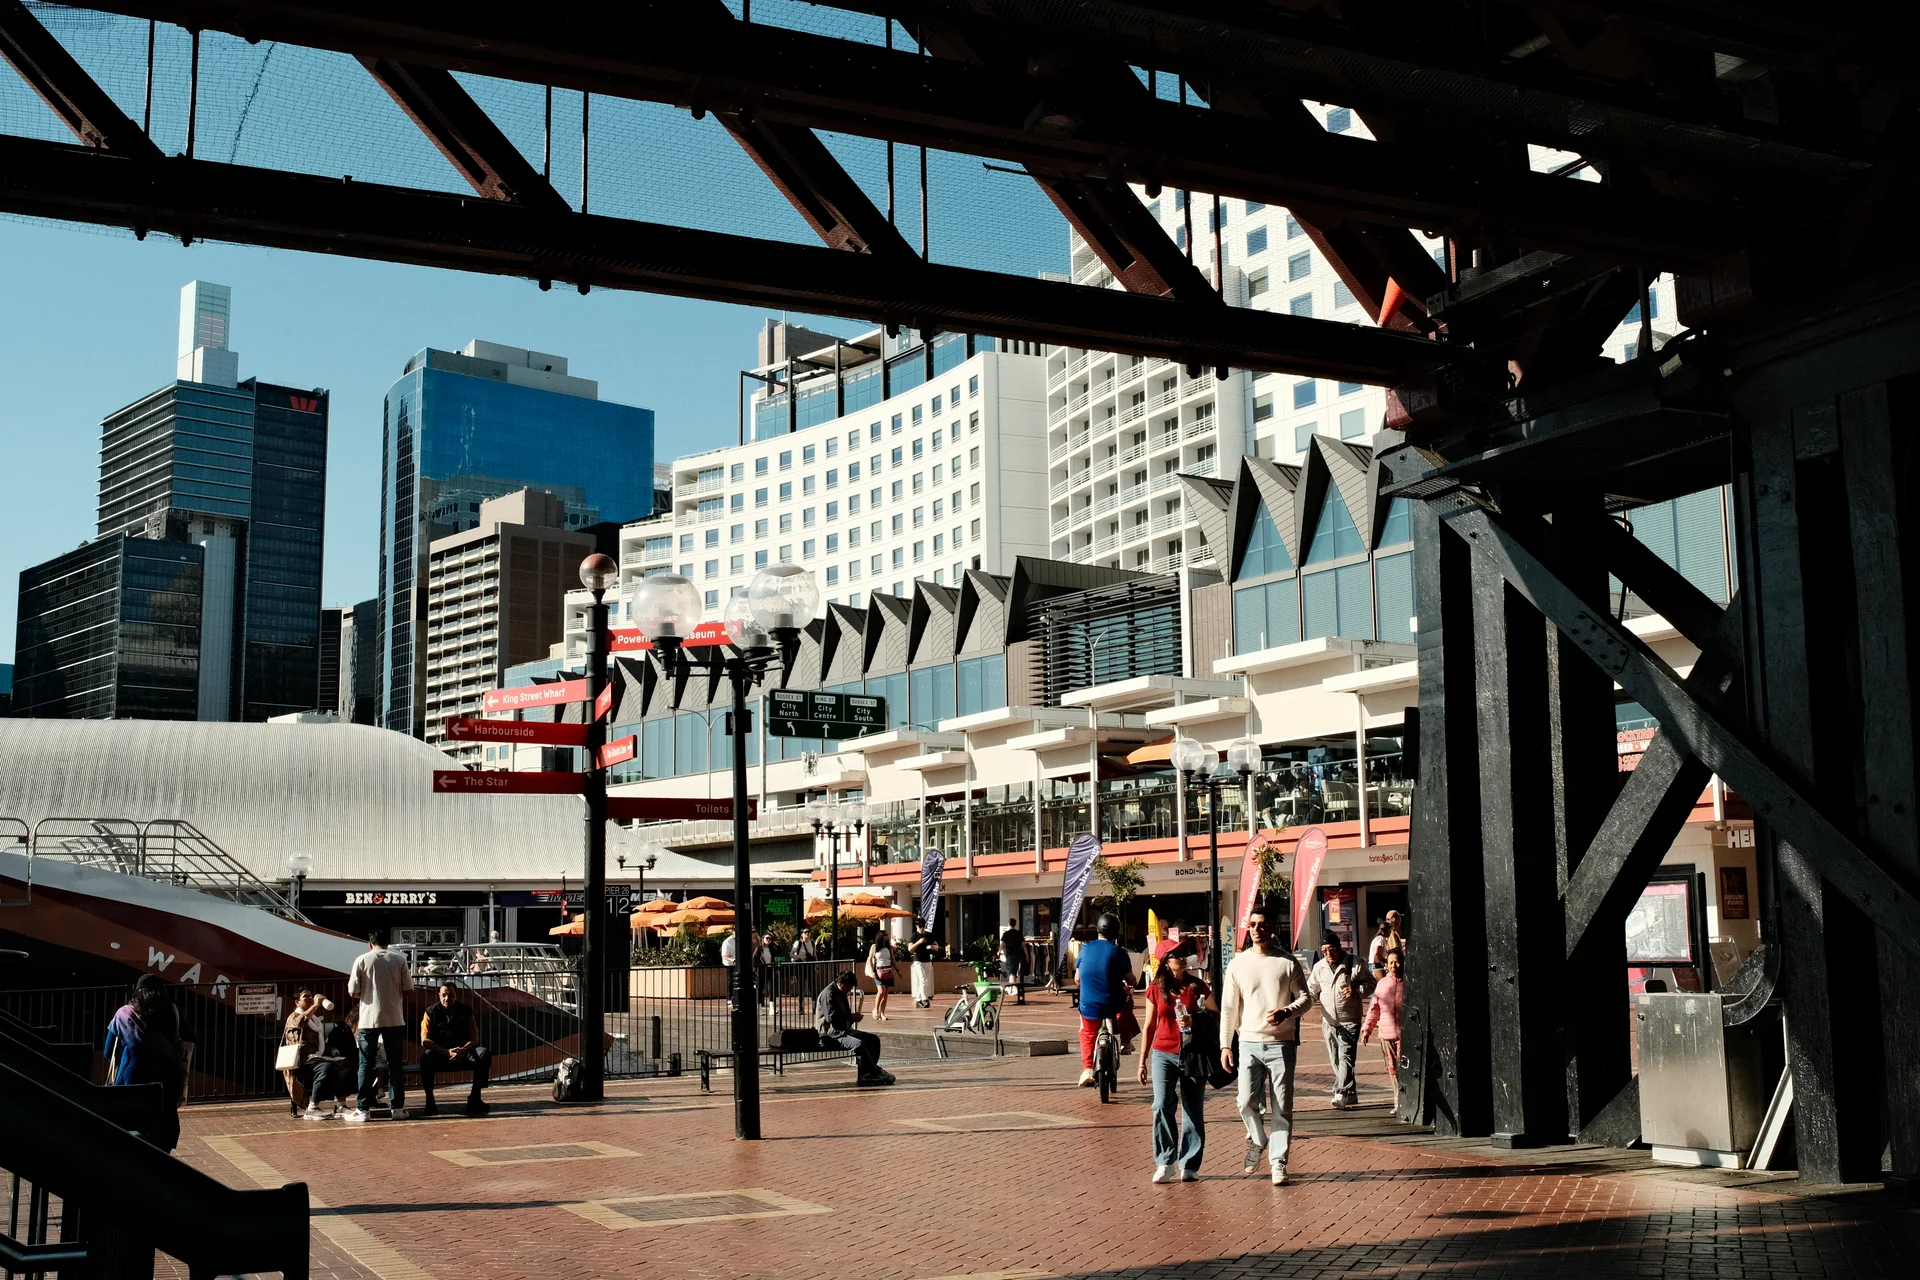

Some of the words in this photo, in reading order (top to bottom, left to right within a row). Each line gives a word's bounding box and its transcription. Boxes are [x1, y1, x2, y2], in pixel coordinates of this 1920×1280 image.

[503, 694, 518, 704] King
[520, 690, 542, 700] Street
[544, 687, 566, 698] Wharf
[474, 725, 534, 737] Harbourside
[464, 776, 484, 786] The
[486, 776, 508, 787] Star
[695, 804, 730, 814] Toilets
[1301, 876, 1316, 911] Taronga
[1310, 857, 1321, 874] Zoo
[1062, 888, 1082, 930] Between
[1079, 869, 1090, 886] the
[1240, 903, 1252, 928] Whale
